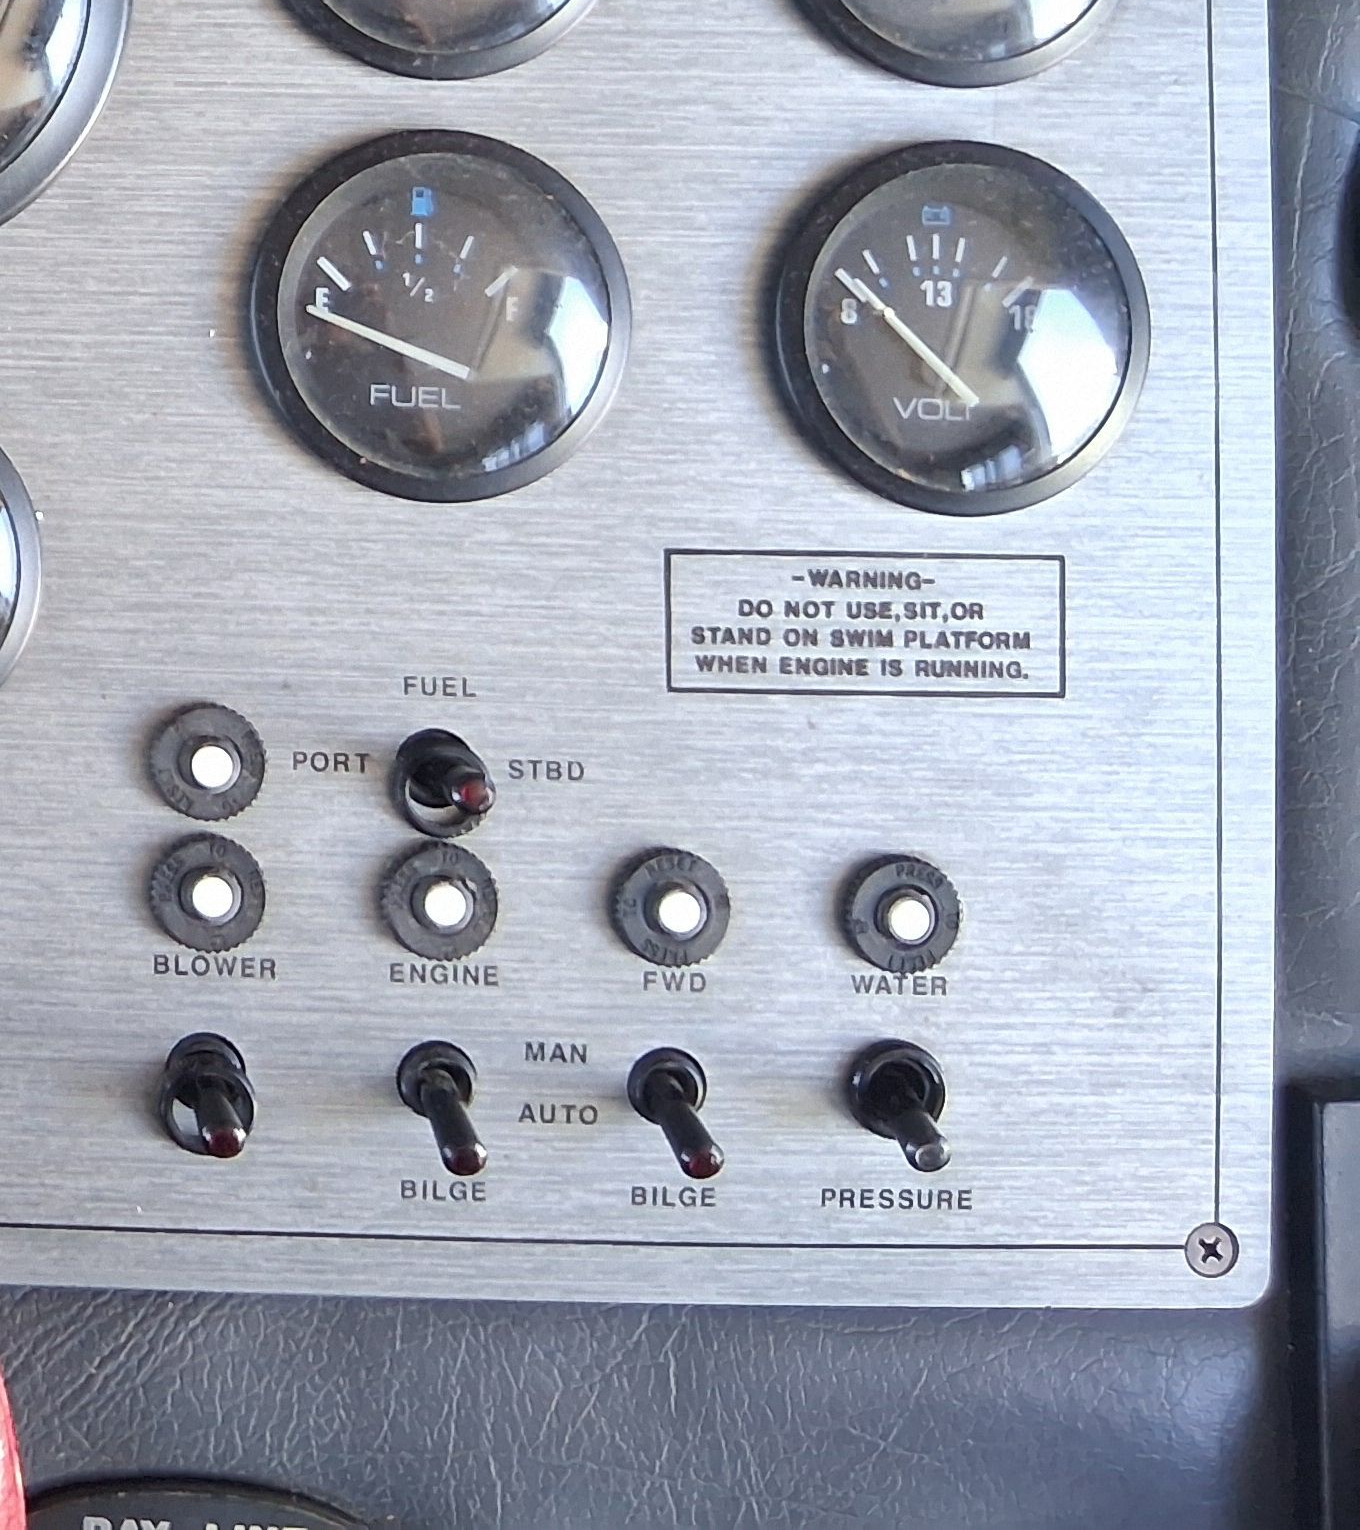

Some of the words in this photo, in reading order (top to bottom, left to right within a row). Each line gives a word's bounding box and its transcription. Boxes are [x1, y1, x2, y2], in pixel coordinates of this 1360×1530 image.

[315, 286, 331, 313] E
[920, 280, 953, 307] 13
[369, 384, 462, 410] FUEL
[738, 599, 773, 617] DO
[784, 600, 835, 618] NOT
[690, 627, 771, 646] STAND
[783, 628, 818, 647] ON
[830, 629, 894, 648] SWIM
[903, 630, 1031, 651] PLATFORM
[694, 654, 767, 674] WHEN
[779, 656, 869, 676] ENGINE
[880, 658, 903, 677] IS
[914, 659, 1029, 680] RUNNING.
[403, 676, 477, 698] FUEL
[292, 751, 371, 774] PORT
[508, 759, 585, 781] STBD
[153, 954, 277, 980] BLOWER
[389, 963, 500, 987] ENGINE
[643, 971, 707, 992] FWD
[851, 974, 948, 996] WATER
[525, 1042, 588, 1064] MAN
[518, 1104, 599, 1126] AUTO
[400, 1180, 487, 1202] BILGE
[630, 1187, 716, 1209] BILGE
[821, 1188, 974, 1211] PRESSURE
